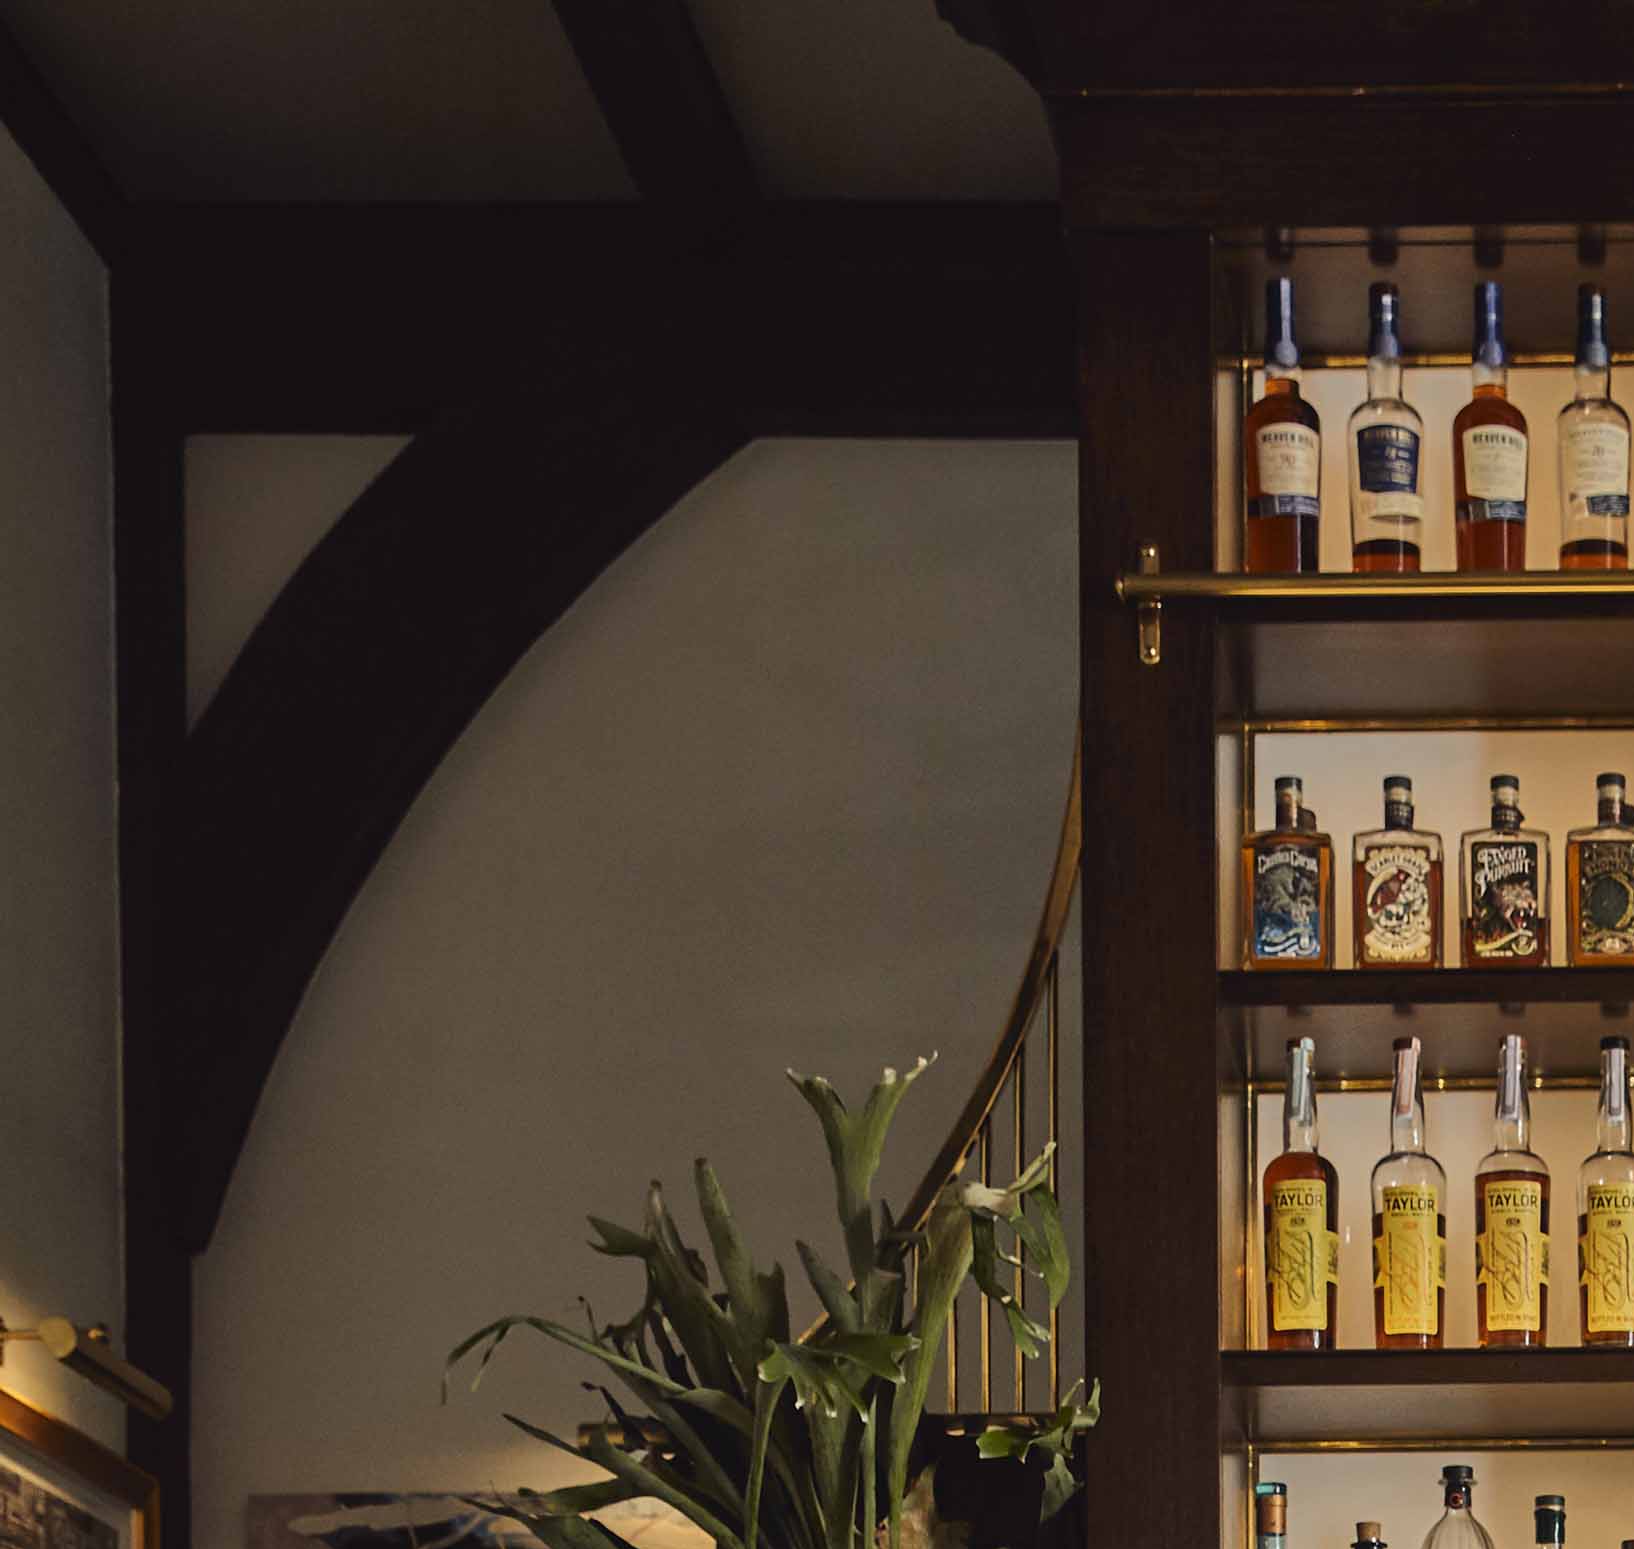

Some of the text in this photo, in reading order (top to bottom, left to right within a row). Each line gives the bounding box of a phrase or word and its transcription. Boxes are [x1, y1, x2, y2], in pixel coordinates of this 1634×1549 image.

[1275, 1193, 1323, 1207] TAYLOR
[1385, 1198, 1435, 1212] TAYLOR
[1488, 1194, 1538, 1208] TAYLOR
